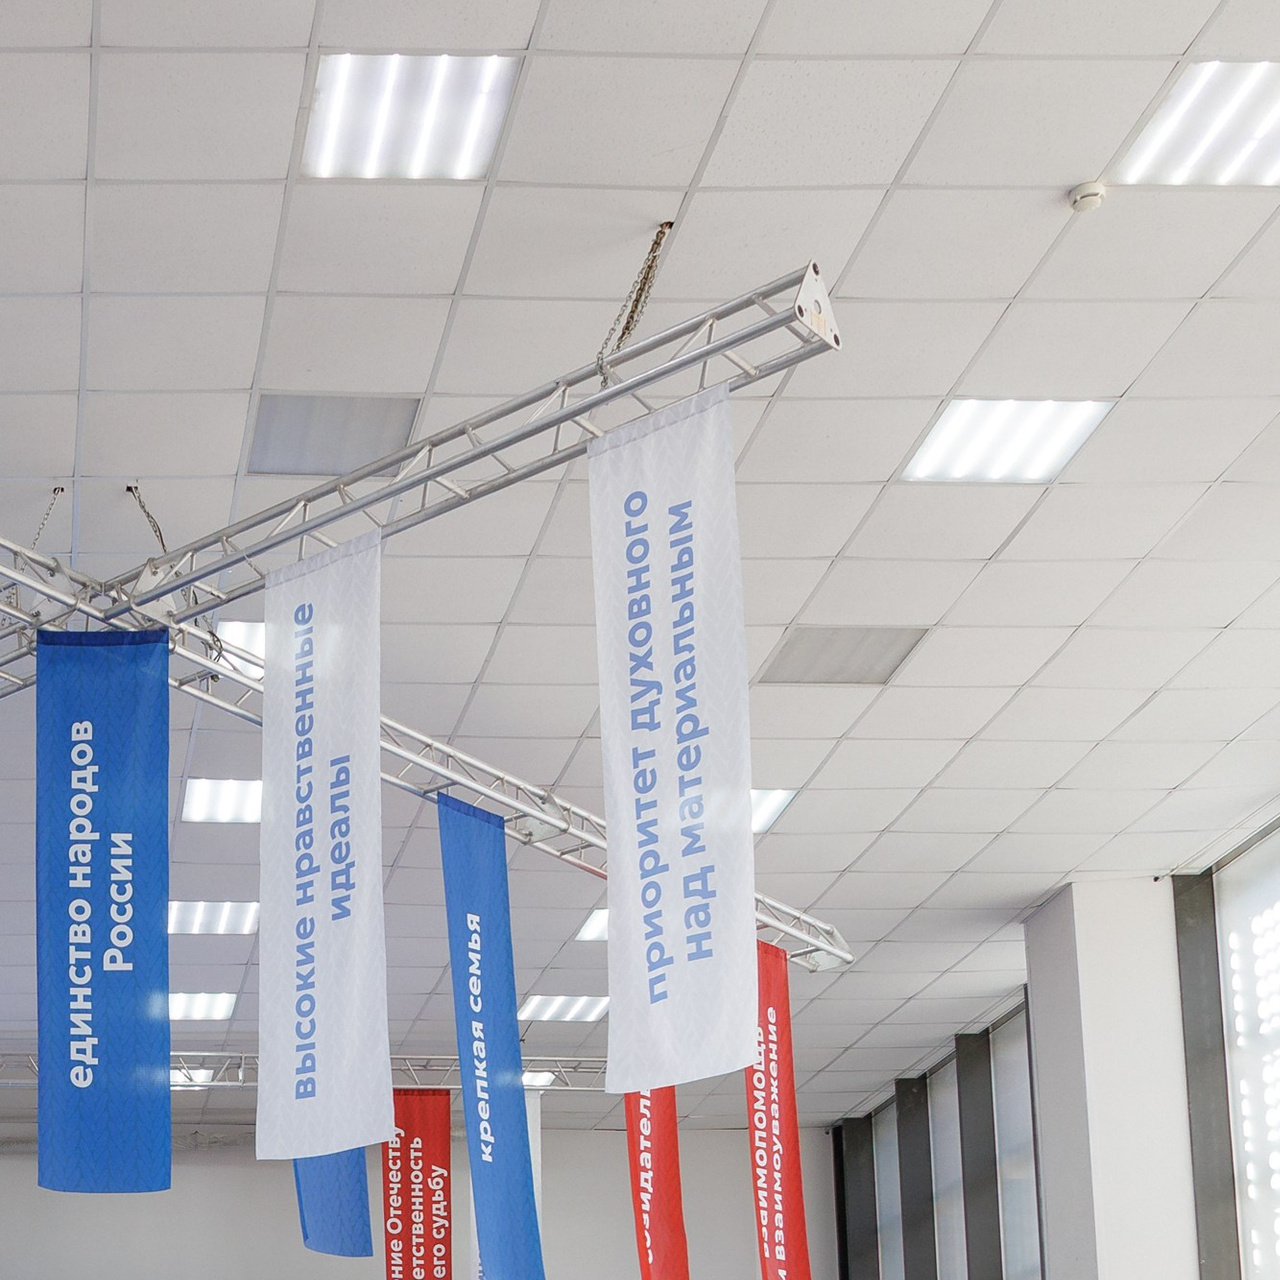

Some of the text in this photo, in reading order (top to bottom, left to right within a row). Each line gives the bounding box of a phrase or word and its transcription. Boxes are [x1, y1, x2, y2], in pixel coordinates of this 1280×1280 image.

[294, 602, 321, 1101] высокие нравственные
[330, 754, 356, 921] идеалы
[623, 490, 674, 1005] приоритет духовного
[668, 500, 716, 962] над материальным
[68, 720, 100, 1089] единство народов
[103, 833, 134, 972] России
[466, 913, 495, 1163] крепкая семья
[767, 1006, 786, 1261] взаимоуважение
[427, 1165, 449, 1246] судьбу
[432, 1250, 446, 1280] его
